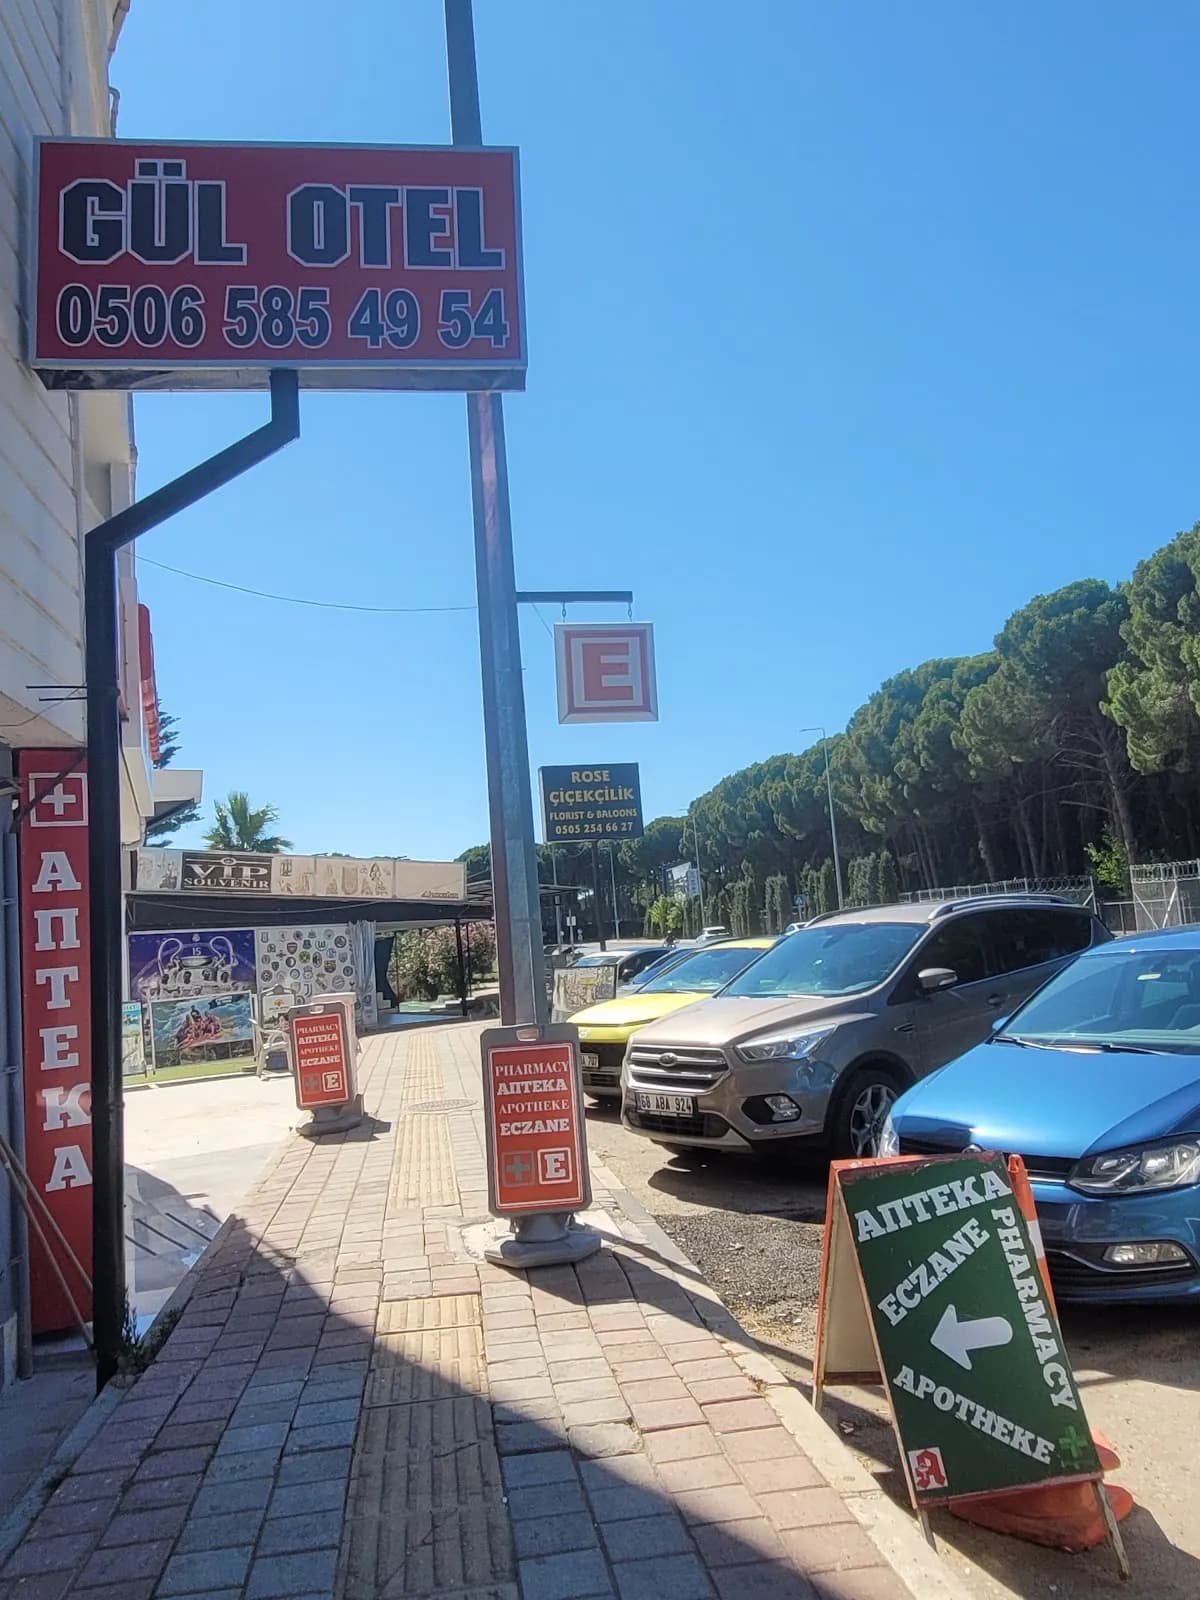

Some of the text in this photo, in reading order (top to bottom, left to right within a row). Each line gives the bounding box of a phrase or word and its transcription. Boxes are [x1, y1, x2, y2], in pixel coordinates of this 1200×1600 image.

[59, 158, 506, 270] GÜL OTEL
[57, 284, 510, 349] 0506 585 49 54
[582, 642, 634, 702] E
[571, 770, 610, 783] ROSE
[549, 785, 634, 807] ÇİÇEKÇİLİK
[549, 808, 637, 821] FLORIST & BALOONS
[555, 824, 581, 835] 0505
[606, 822, 618, 832] 66
[621, 821, 633, 832] 27
[187, 863, 268, 881] VIP
[184, 877, 269, 889] SOUVENIR
[32, 851, 92, 1193] АПТЕКА
[297, 1024, 338, 1034] PHARMACY
[301, 1055, 340, 1067] ECZANE
[495, 1061, 570, 1077] PHARMACY
[326, 1074, 339, 1089] E
[497, 1079, 568, 1096] АПТЕКА
[498, 1099, 570, 1115] APOTHEKE
[656, 1096, 670, 1110] ABA
[675, 1097, 692, 1112] 924
[500, 1118, 570, 1136] ECZANE
[544, 1153, 566, 1179] E
[854, 1170, 1012, 1242] АПТЕКА
[877, 1218, 990, 1326] ECZANE
[992, 1205, 1077, 1411] PHARMACY
[893, 1365, 1055, 1464] APOTHEKE
